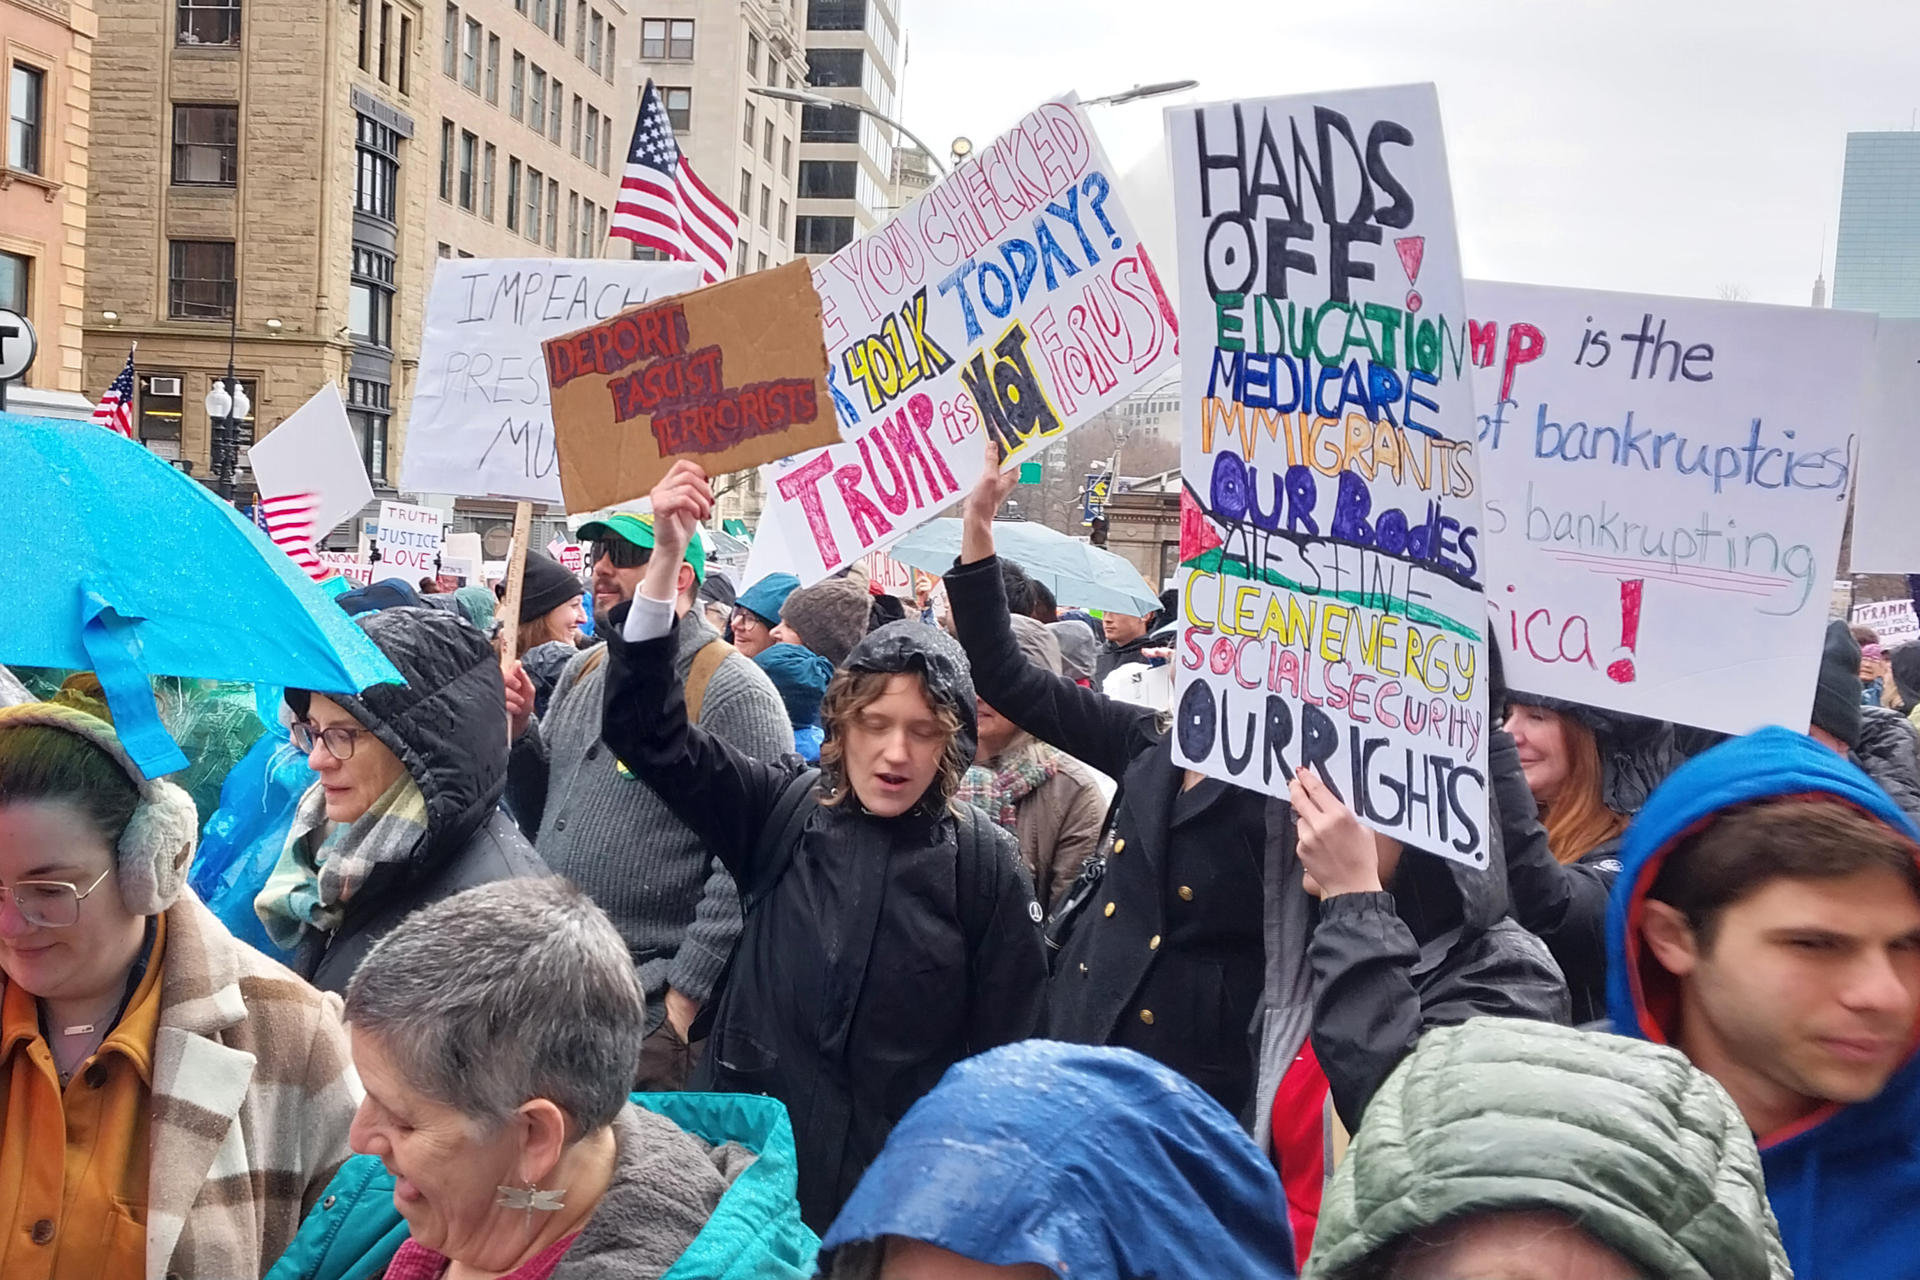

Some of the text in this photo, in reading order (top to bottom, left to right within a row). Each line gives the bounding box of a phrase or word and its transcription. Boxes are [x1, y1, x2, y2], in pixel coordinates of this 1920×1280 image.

[1195, 103, 1414, 229] HANDS
[830, 216, 926, 323] YOU
[918, 103, 1090, 266] CHECKED
[457, 271, 649, 326] IMPEACH
[842, 285, 957, 414] 401K
[937, 171, 1123, 346] TODAY?
[1204, 211, 1425, 312] OFF!
[550, 303, 690, 384] DEPORT
[1214, 293, 1466, 381] EDUCATION
[1469, 313, 1715, 403] MP is the
[427, 352, 551, 418] PRES
[606, 346, 724, 424] FASCIST
[651, 380, 816, 458] TERRORISTS
[1207, 346, 1442, 440] MEDICARE
[477, 416, 561, 479] MU
[776, 391, 962, 571] TRUMP
[1202, 396, 1475, 499] IMMIGRANTS
[387, 507, 438, 524] TRUTH
[1210, 450, 1319, 536] OUR
[379, 528, 439, 549] JUSTICE
[382, 548, 430, 571] LOVE
[1525, 480, 1817, 616] bankrupting
[1488, 578, 1645, 685] ica!
